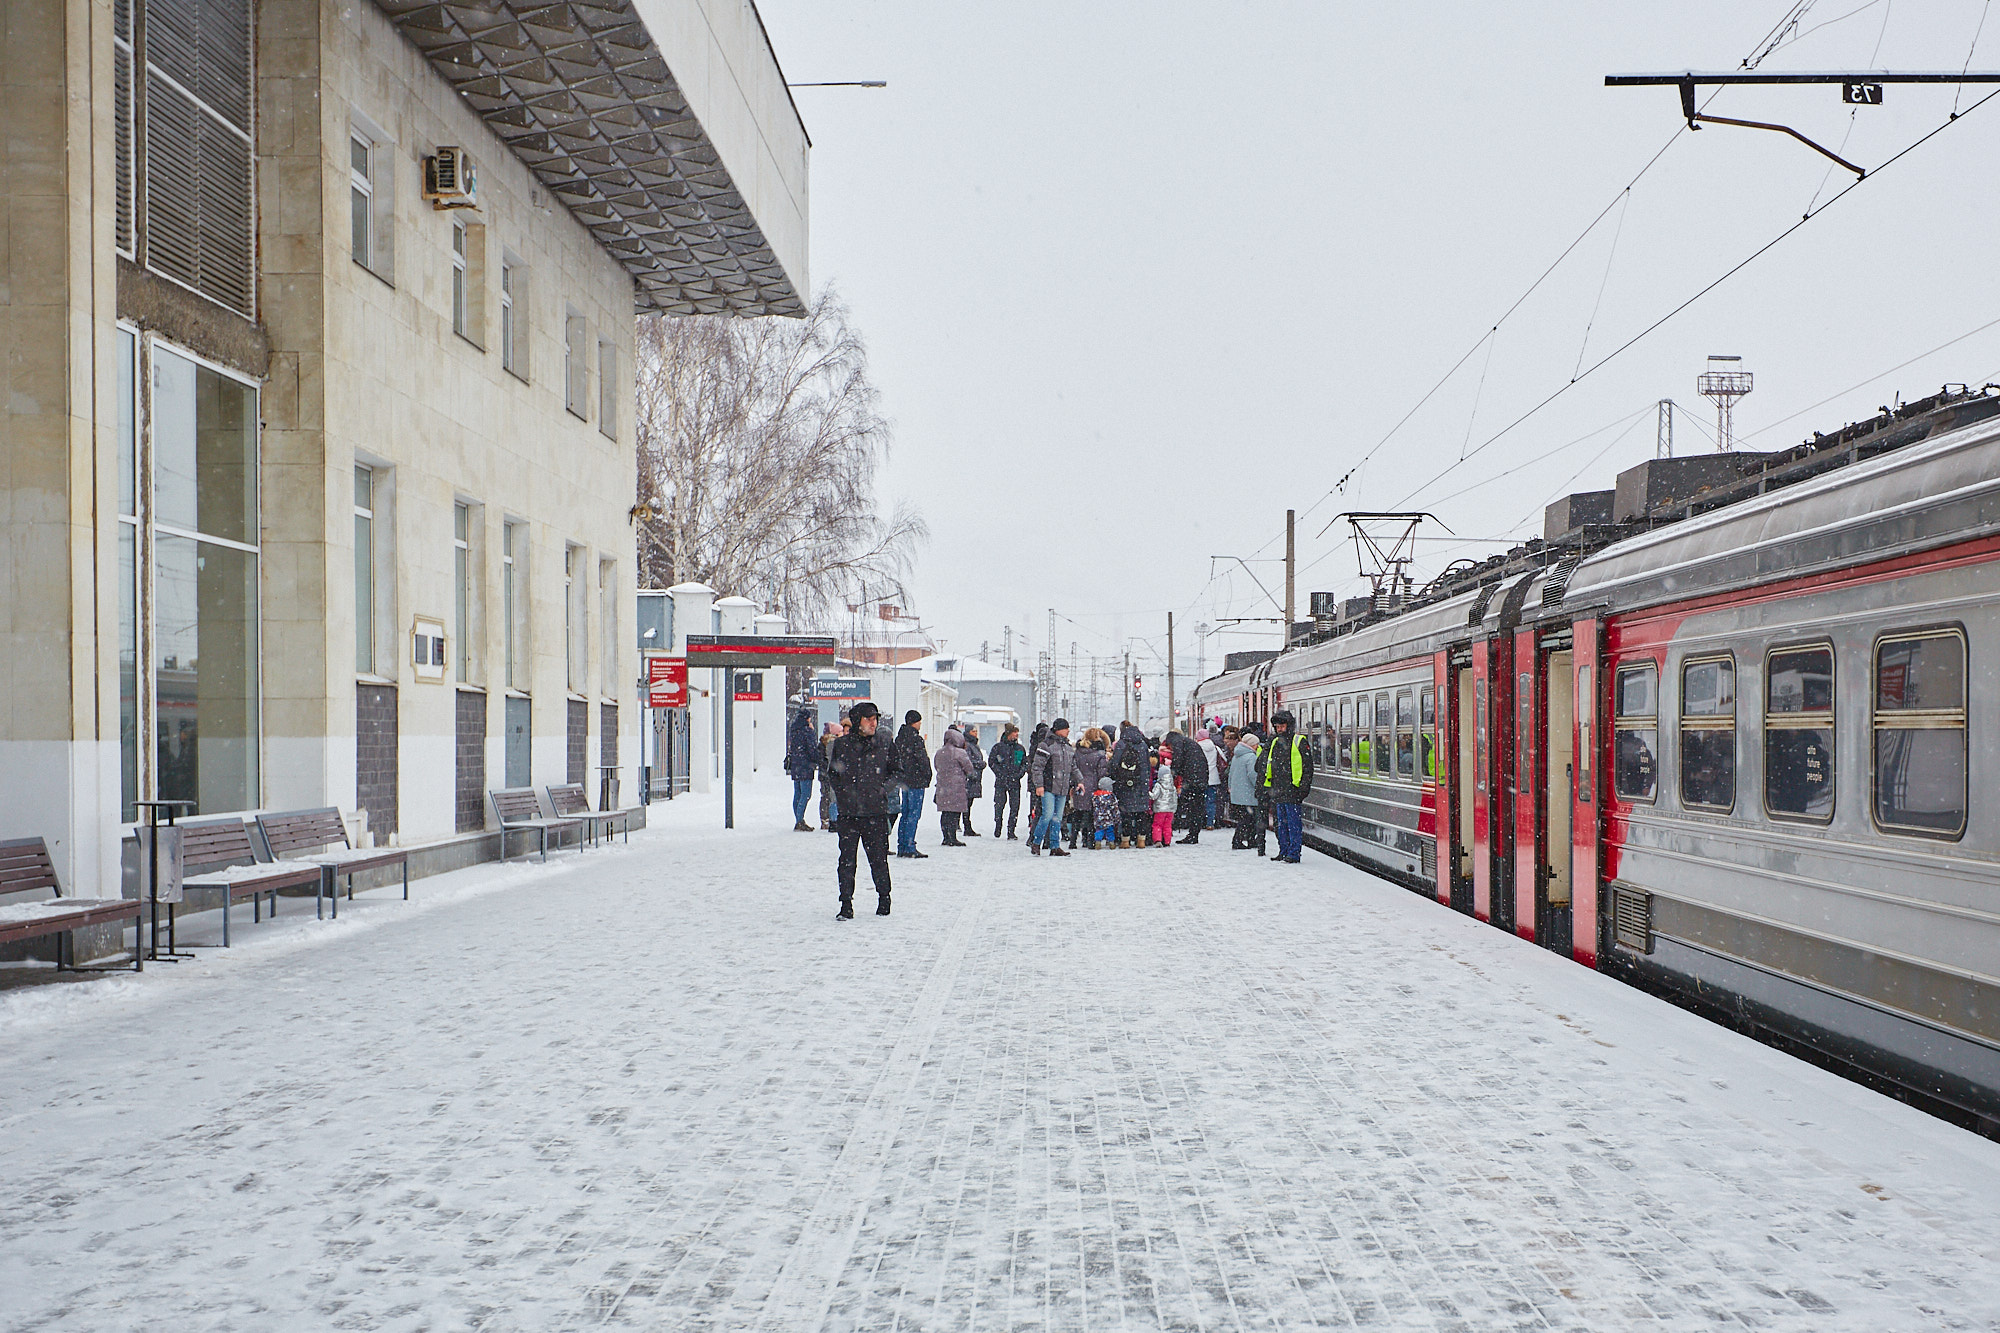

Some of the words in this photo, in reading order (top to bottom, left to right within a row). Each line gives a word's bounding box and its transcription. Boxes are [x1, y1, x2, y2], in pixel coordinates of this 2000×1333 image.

[743, 674, 751, 692] 1
[810, 681, 818, 697] 1
[817, 681, 857, 690] Платформа
[1807, 744, 1816, 755] alfa
[1807, 757, 1820, 768] future
[1807, 772, 1822, 783] people
